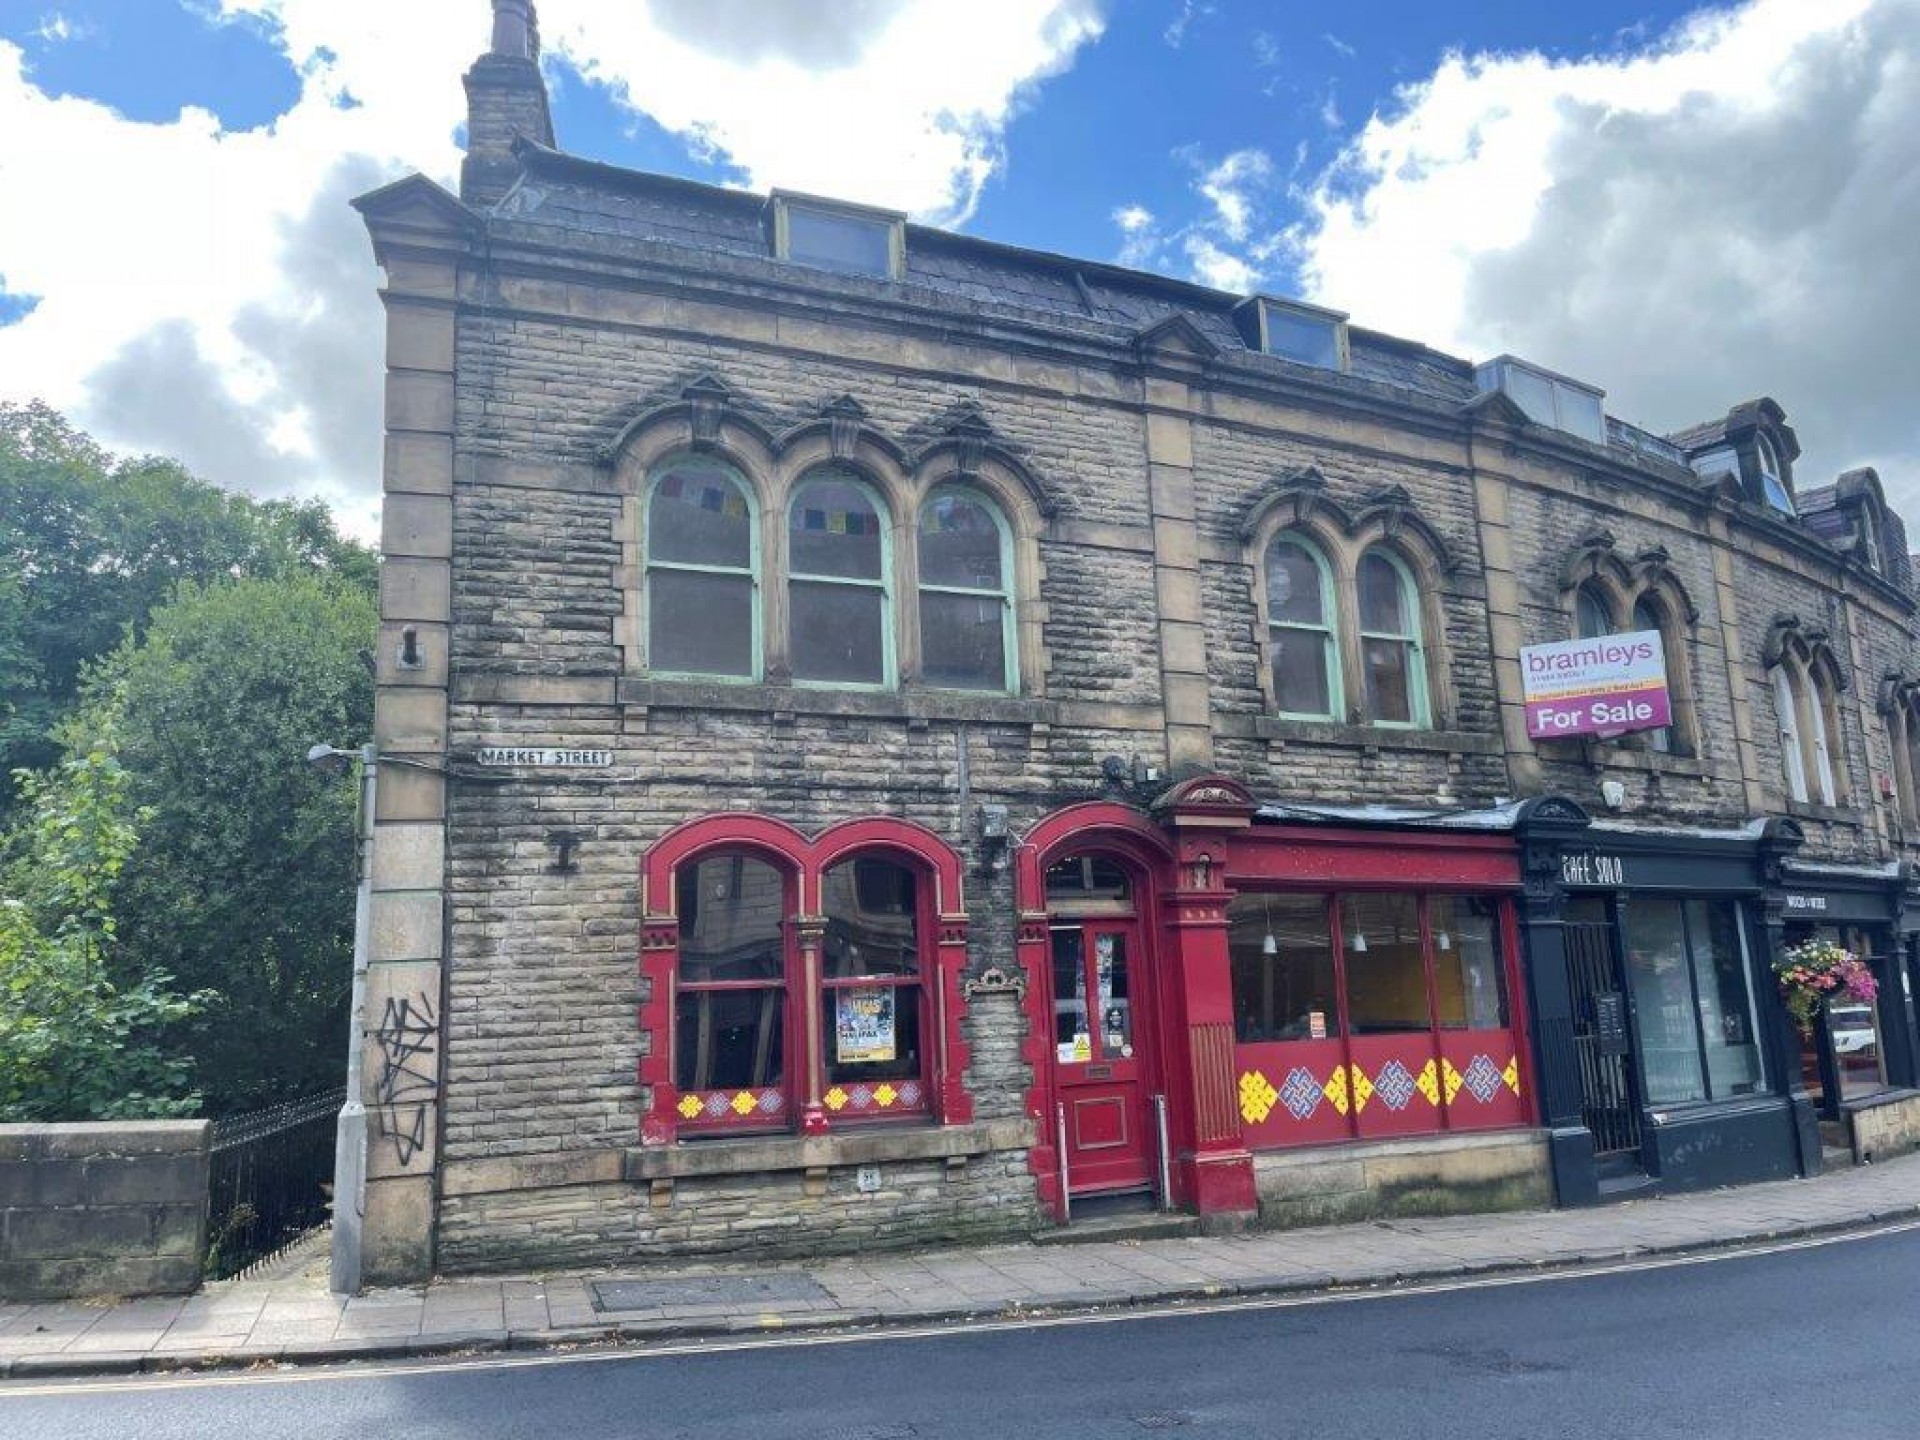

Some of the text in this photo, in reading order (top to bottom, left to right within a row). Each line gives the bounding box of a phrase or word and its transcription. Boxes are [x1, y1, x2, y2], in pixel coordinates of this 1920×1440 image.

[1529, 642, 1653, 672] bramleys
[1537, 701, 1653, 730] For Sale
[481, 752, 608, 764] MARKET STREET
